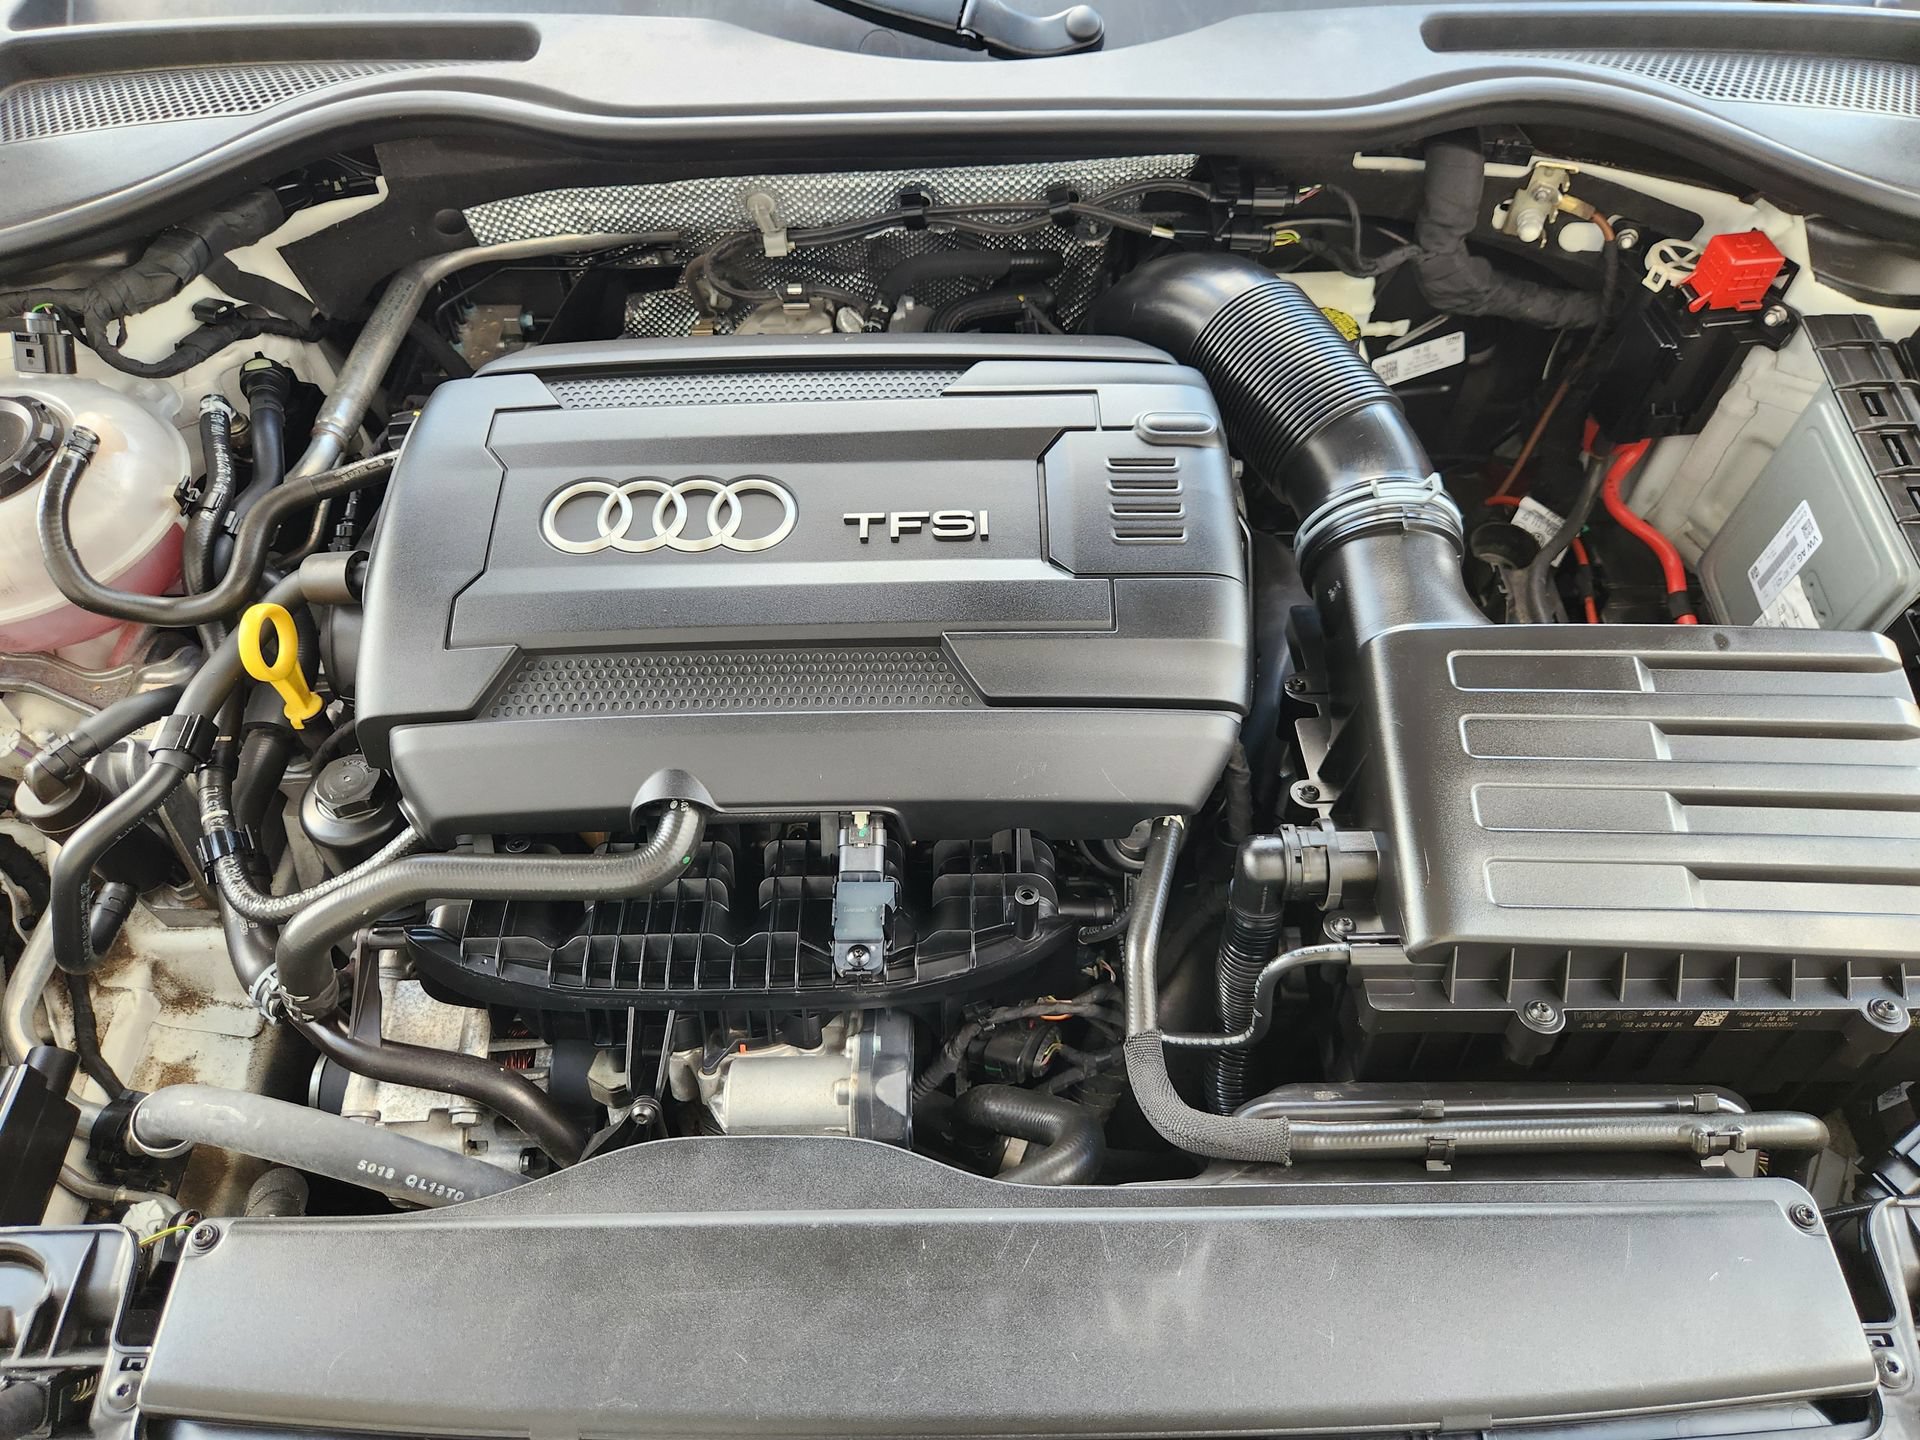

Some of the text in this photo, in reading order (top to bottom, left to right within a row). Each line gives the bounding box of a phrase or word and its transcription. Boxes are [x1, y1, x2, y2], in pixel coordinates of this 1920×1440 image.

[843, 509, 989, 543] TFSI
[1807, 535, 1819, 551] VW
[1796, 549, 1807, 563] AG
[357, 1159, 396, 1179] 5018
